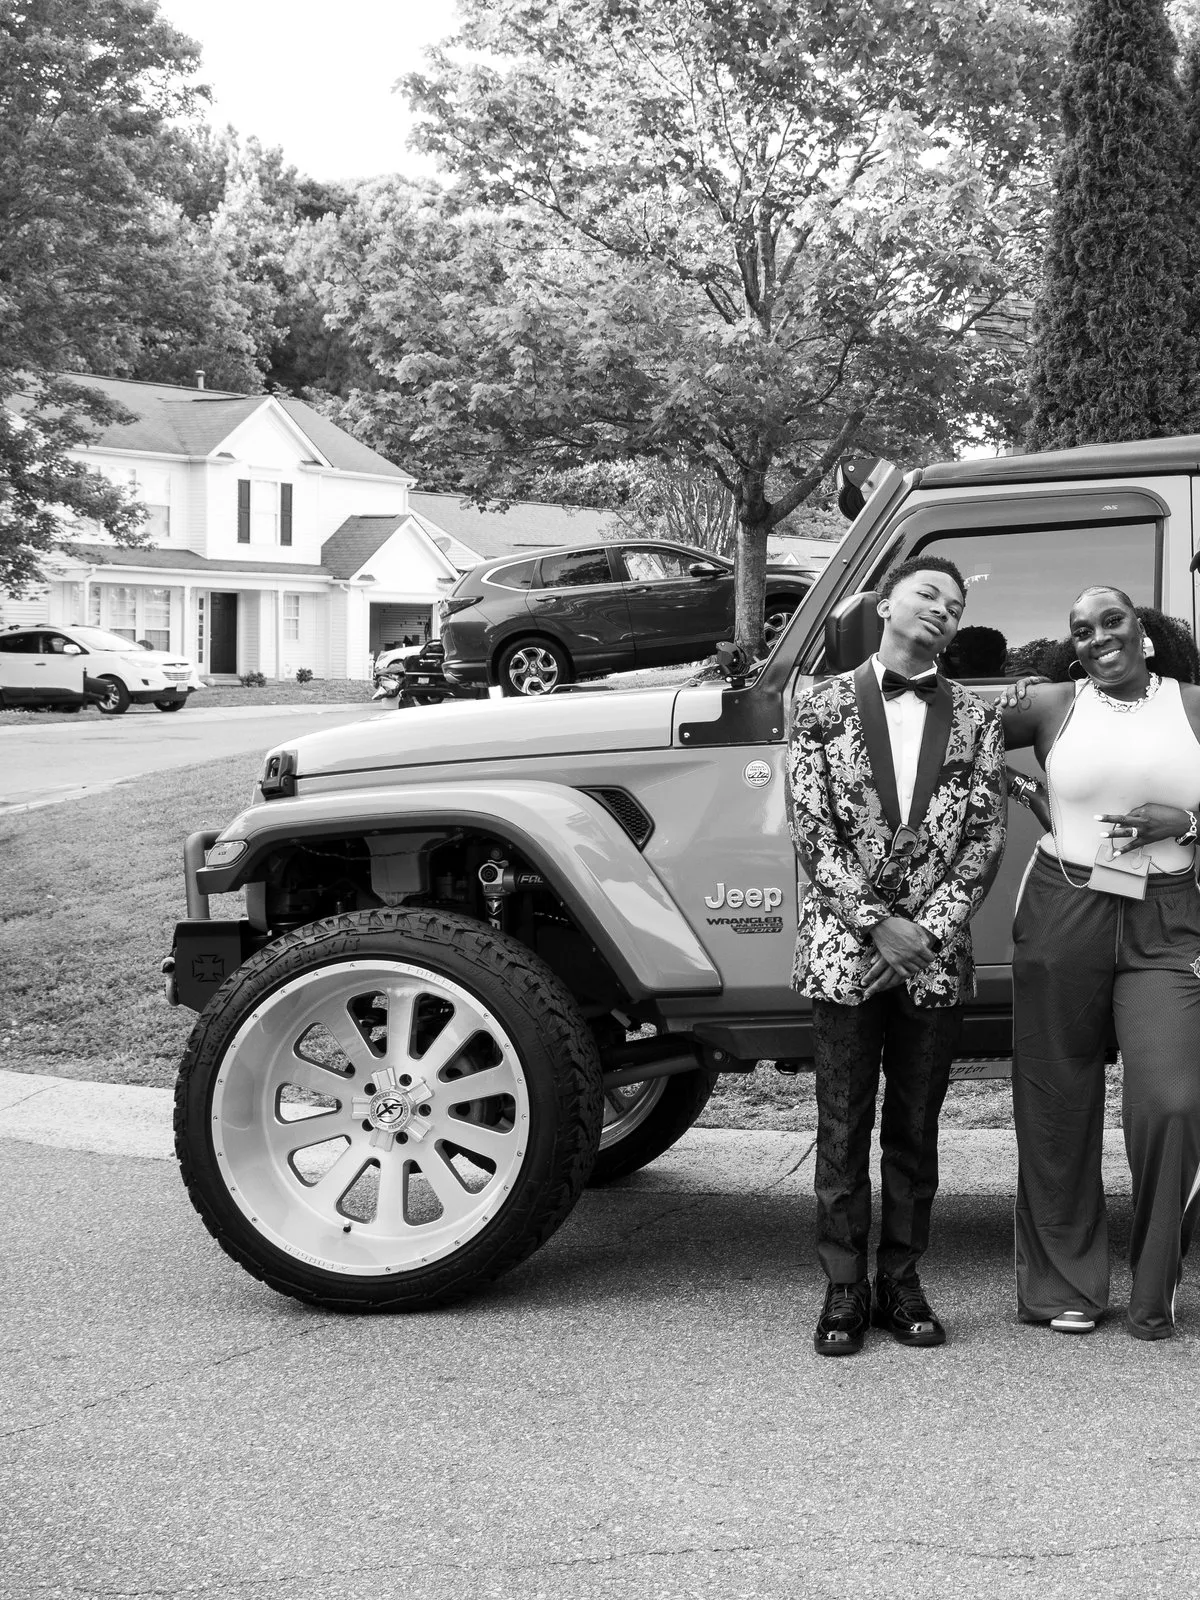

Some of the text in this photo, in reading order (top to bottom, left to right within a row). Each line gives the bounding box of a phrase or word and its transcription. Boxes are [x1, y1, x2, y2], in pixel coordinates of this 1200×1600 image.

[704, 882, 783, 912] Jeep
[706, 916, 783, 926] WRANGLER
[736, 926, 782, 934] SPORT
